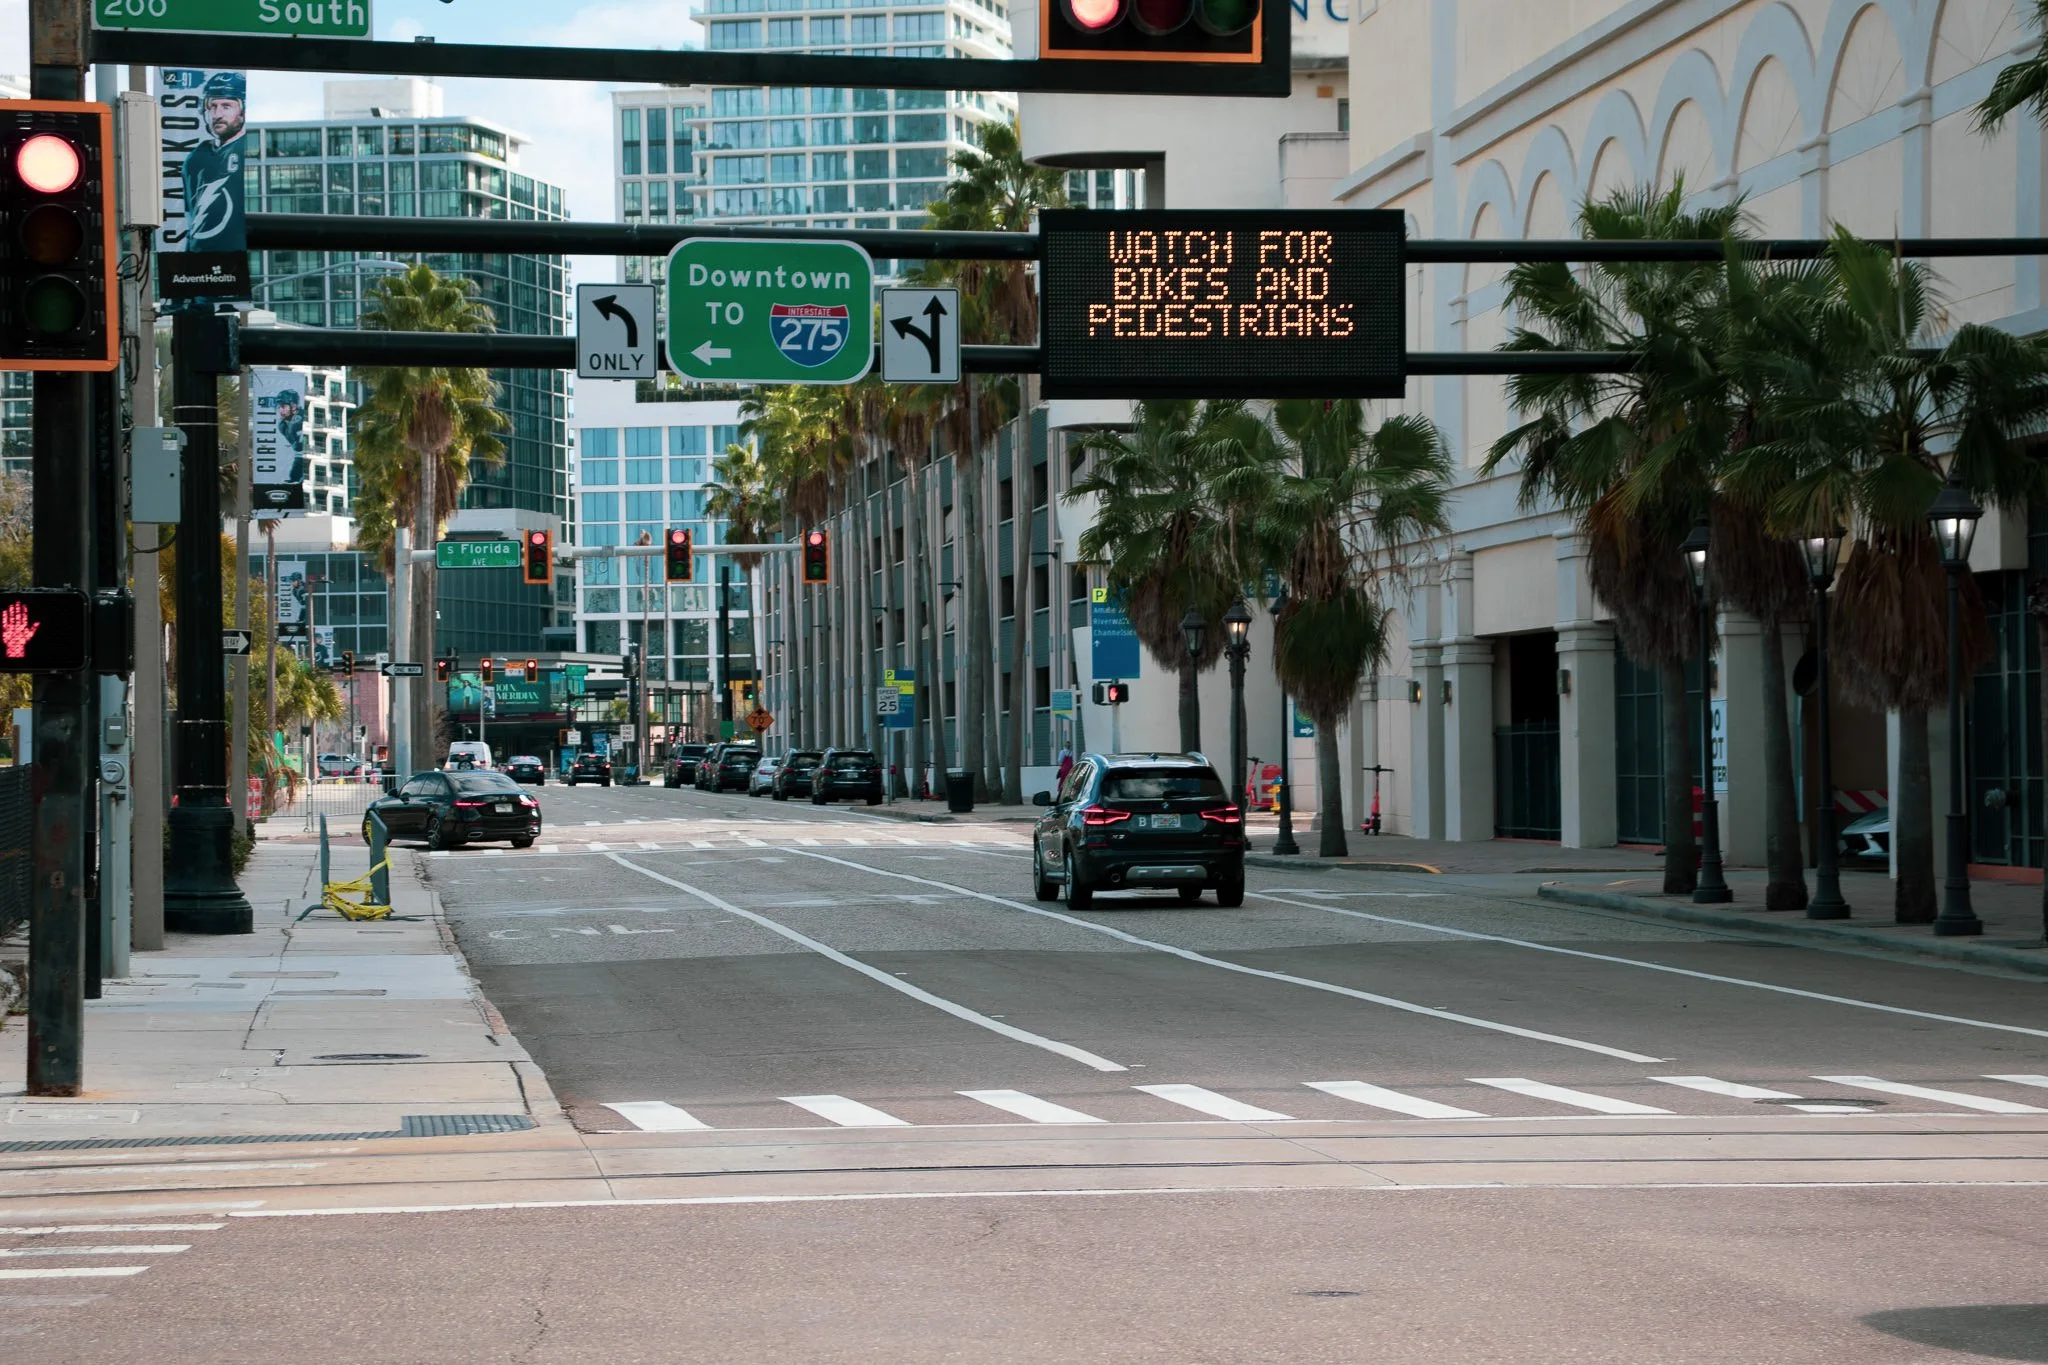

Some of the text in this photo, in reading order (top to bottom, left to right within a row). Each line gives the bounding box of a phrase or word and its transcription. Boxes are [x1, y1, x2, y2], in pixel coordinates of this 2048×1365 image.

[258, 0, 364, 26] South
[1109, 230, 1333, 263] WATCH FOR
[172, 273, 236, 283] AdventHealth
[689, 263, 851, 289] Downtown
[1114, 267, 1328, 300] BIKES AND
[706, 302, 744, 325] TO
[787, 307, 832, 317] INTERSTATE
[1089, 304, 1354, 336] PEDESTRIANS
[780, 319, 842, 351] 275
[589, 353, 645, 371] ONLY
[257, 411, 276, 473] CIRELLI
[461, 543, 510, 554] Florida
[472, 558, 486, 566] AVE
[280, 583, 292, 618] CIRELLI
[1096, 590, 1104, 600] P
[879, 701, 897, 712] 25
[1138, 816, 1147, 827] B
